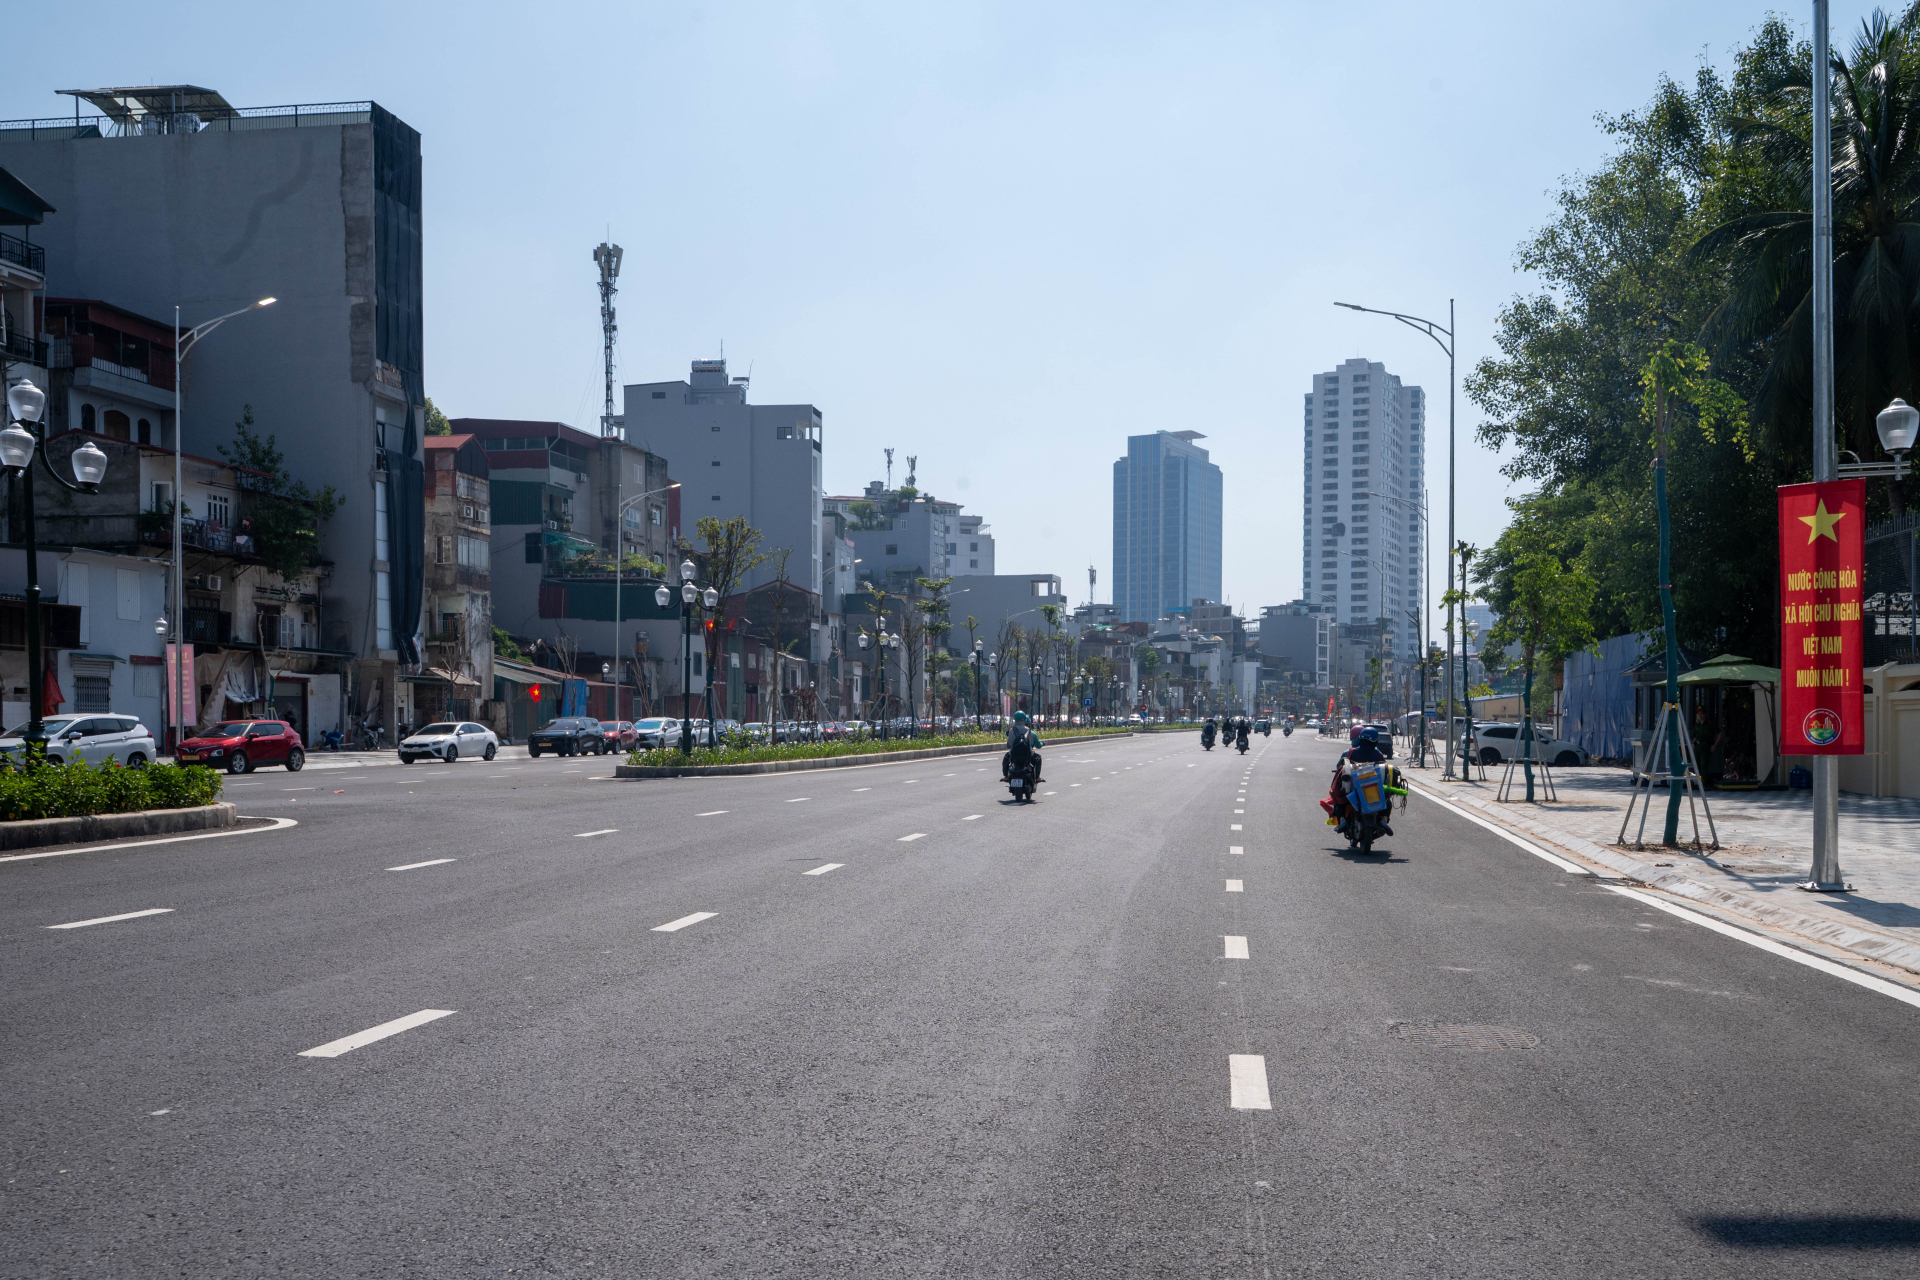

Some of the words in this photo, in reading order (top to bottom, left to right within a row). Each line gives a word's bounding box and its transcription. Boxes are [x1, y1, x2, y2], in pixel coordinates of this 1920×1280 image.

[1788, 568, 1812, 591] NƯỚC
[1813, 567, 1837, 593] CỘNG
[1839, 565, 1857, 589] HÒA
[1785, 602, 1797, 623] XÃ
[1799, 601, 1812, 627] HỘI
[1814, 598, 1831, 622] CHỦ
[1833, 599, 1861, 622] NGHĨA
[1803, 633, 1819, 659] VIỆT
[1821, 636, 1842, 655] NAM
[1796, 666, 1820, 687] MUÔN
[1822, 665, 1843, 687] NĂM
